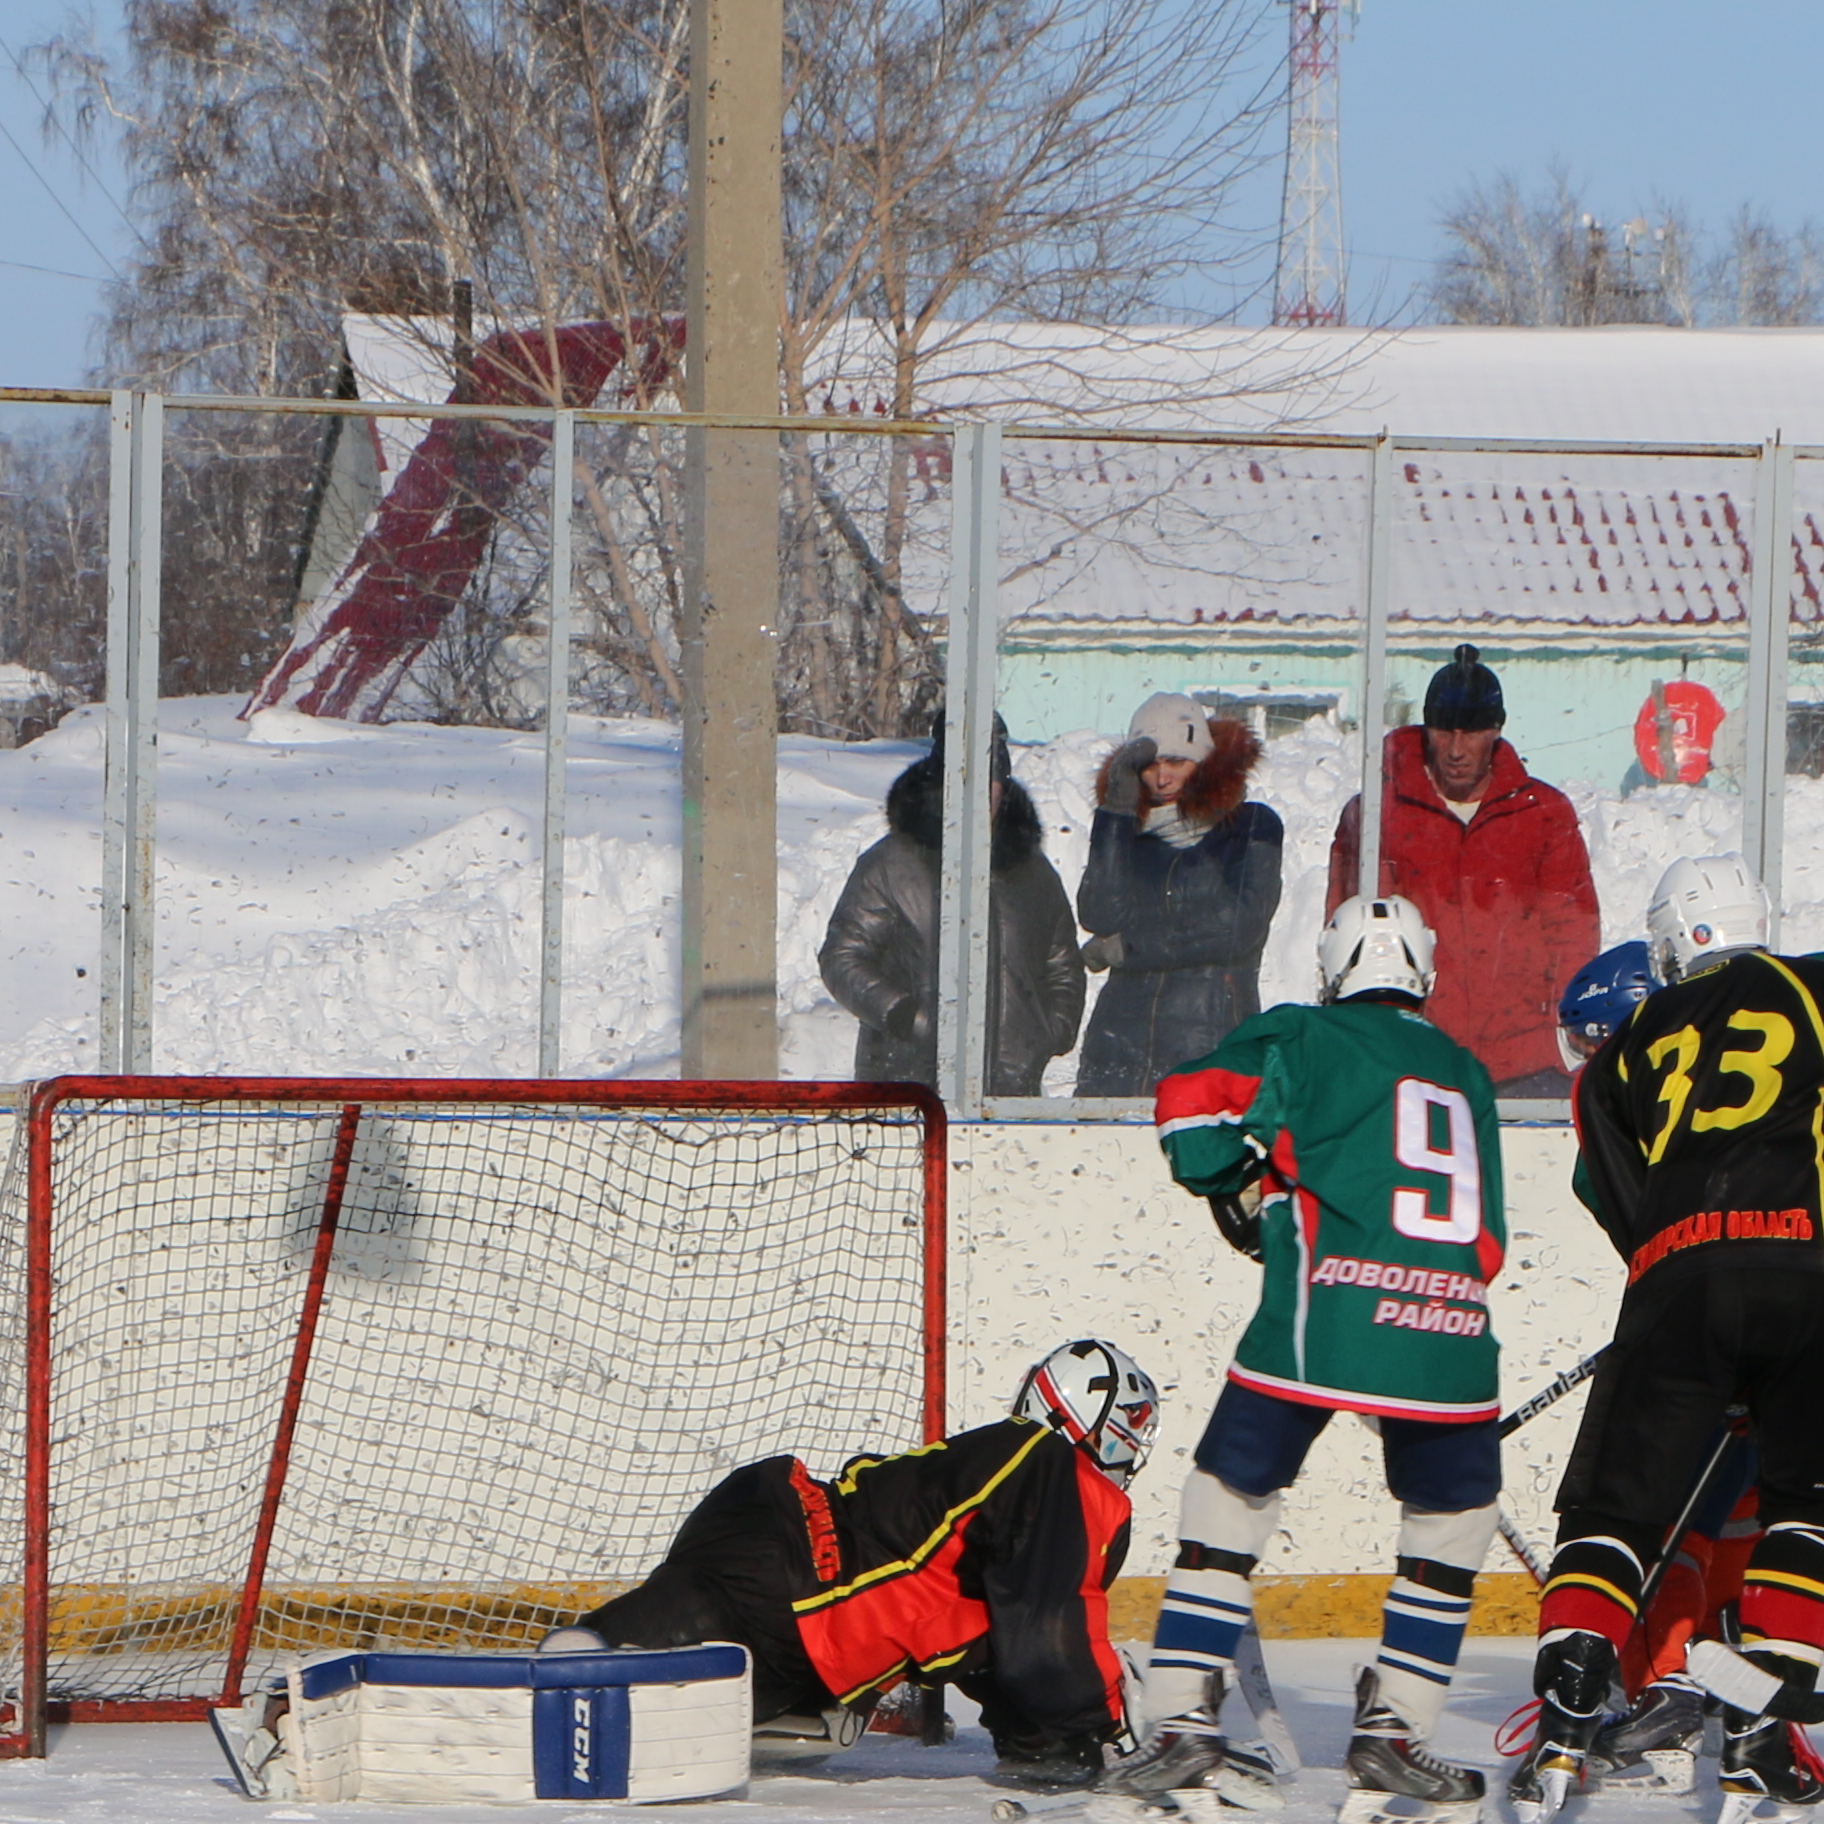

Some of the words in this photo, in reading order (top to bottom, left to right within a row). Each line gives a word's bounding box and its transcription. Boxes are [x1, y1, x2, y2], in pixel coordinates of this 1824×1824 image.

[1646, 1008, 1796, 1167] 33
[1391, 1075, 1484, 1245] 9
[1726, 1207, 1814, 1241] ОБЛАСТЬ
[1373, 1297, 1487, 1337] РАЙОН
[572, 1697, 591, 1784] CCM
